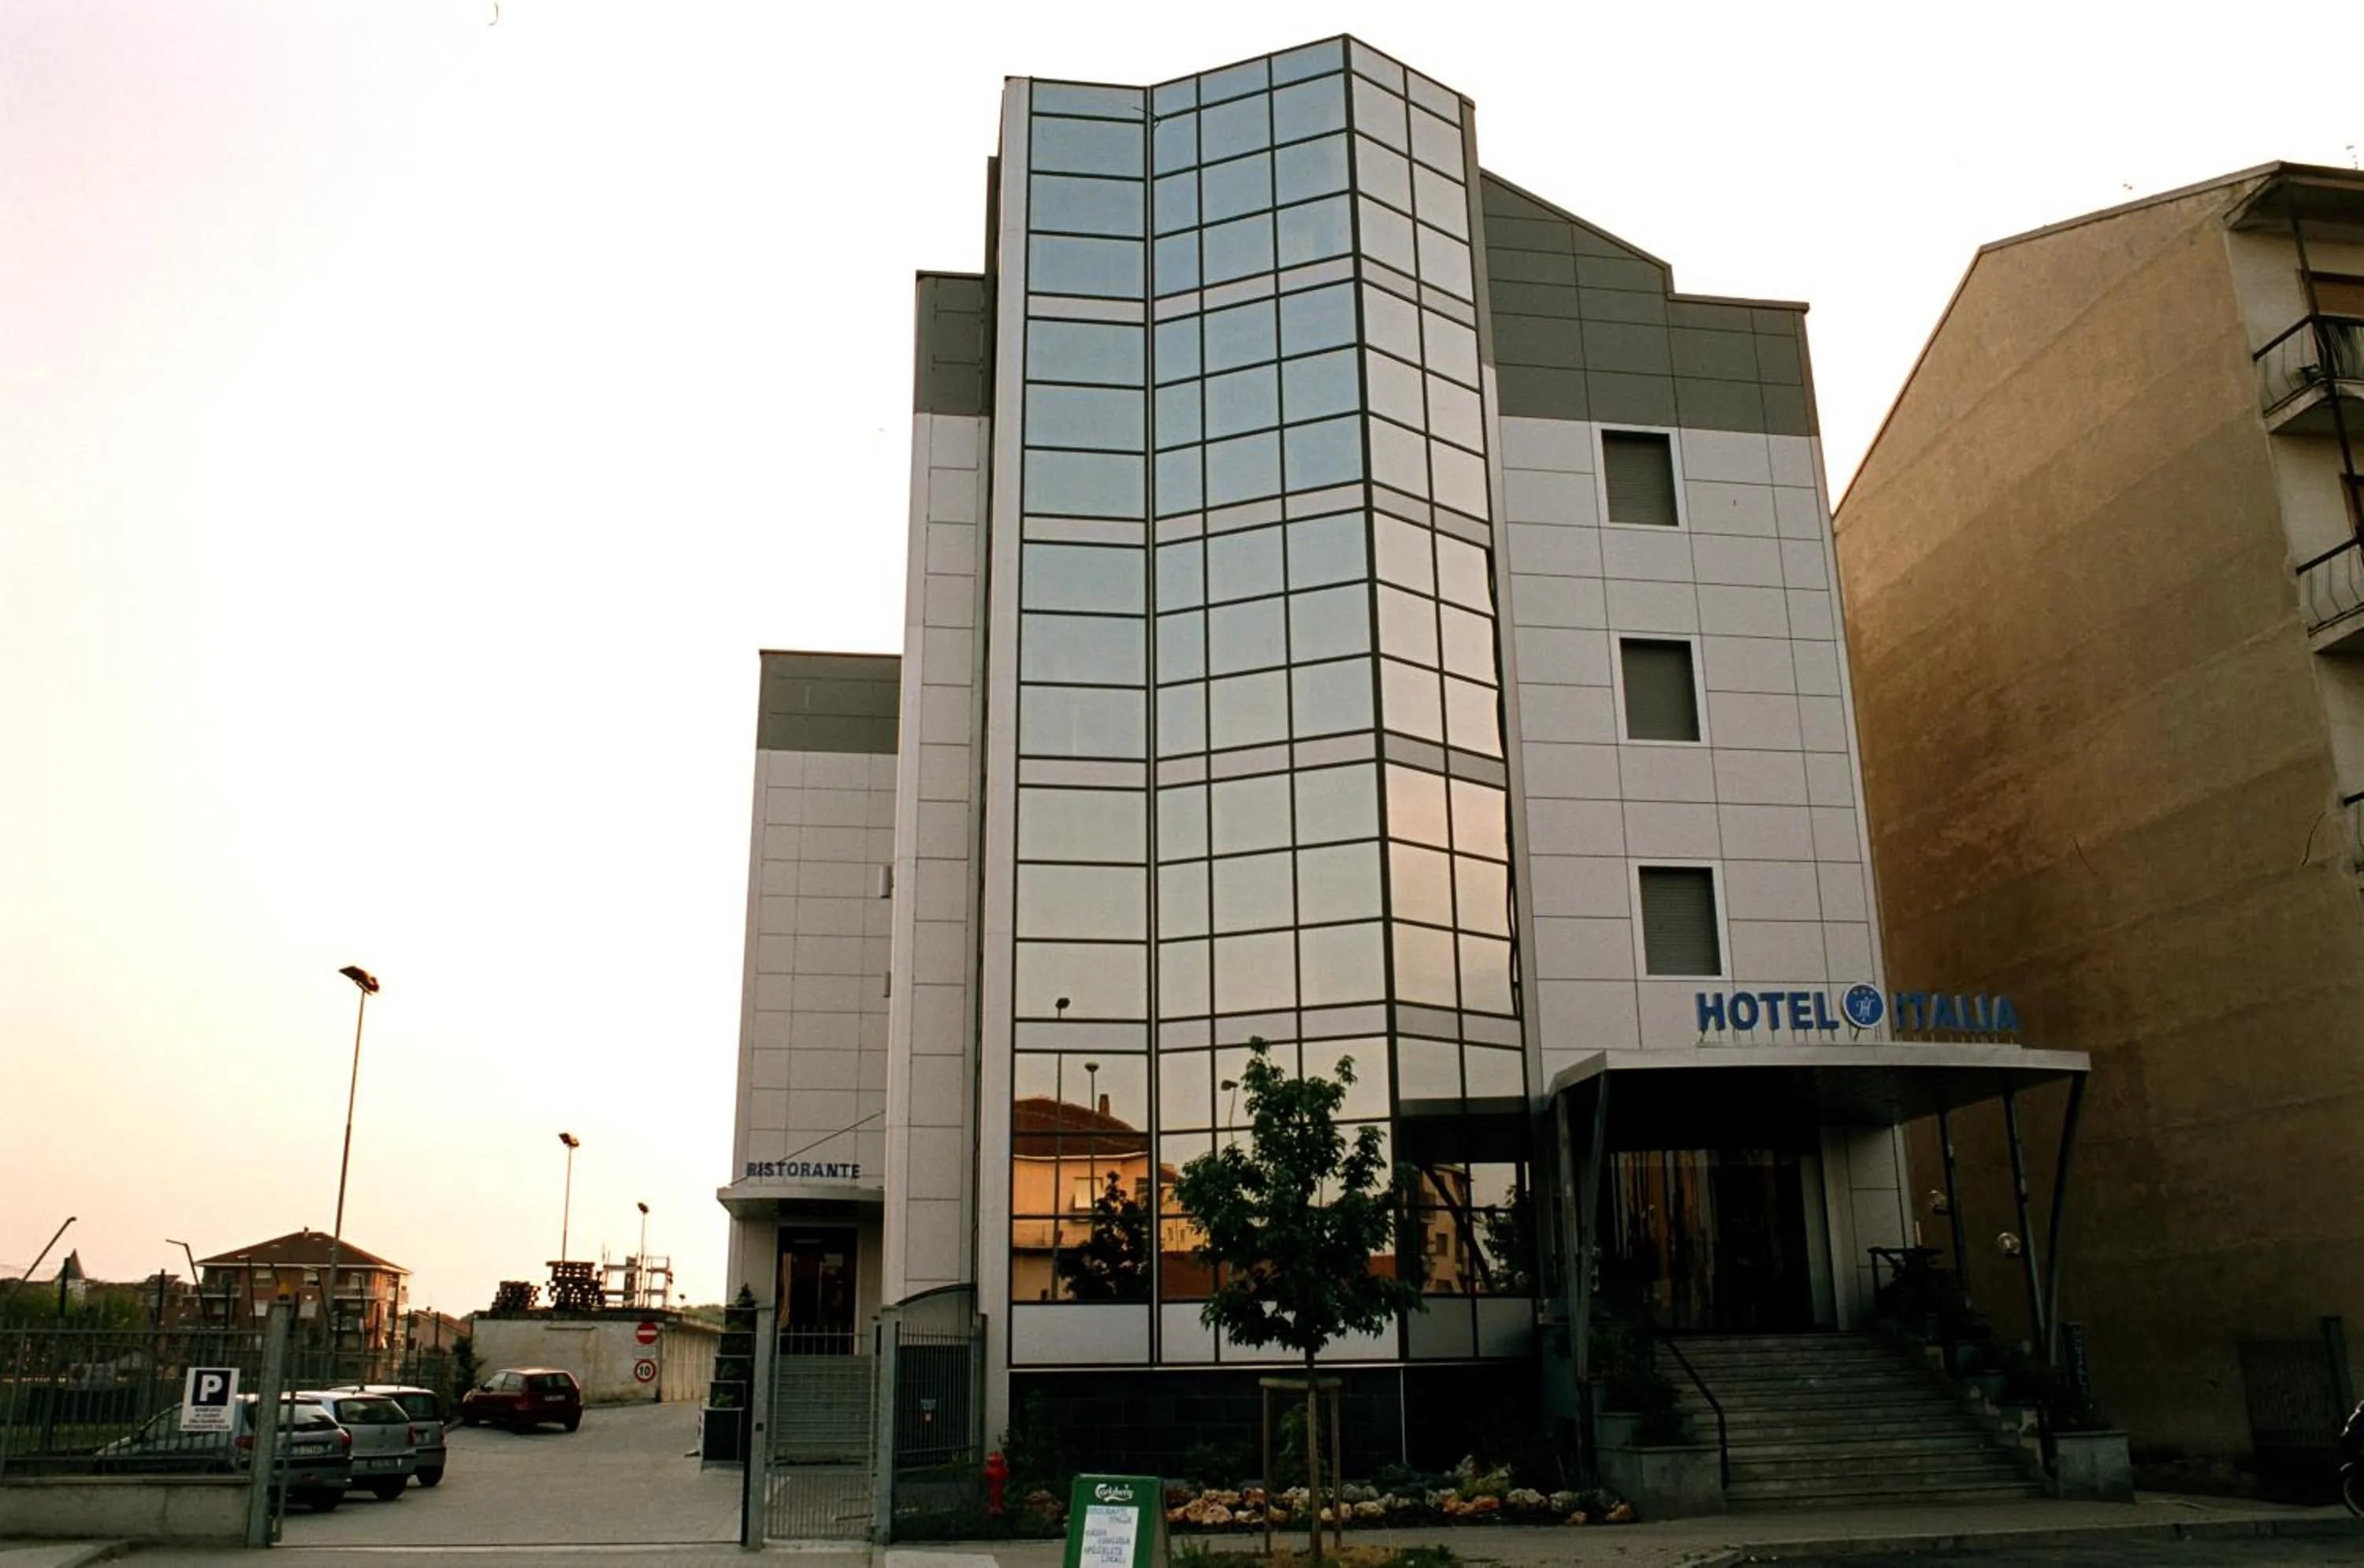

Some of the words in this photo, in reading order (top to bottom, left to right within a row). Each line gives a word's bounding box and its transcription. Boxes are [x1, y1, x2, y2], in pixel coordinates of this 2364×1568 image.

[1696, 991, 1839, 1031] HOTEL
[1891, 993, 2021, 1033] ITALIA
[746, 1161, 861, 1179] RISTORANTE
[640, 1365, 651, 1376] 10
[199, 1373, 223, 1402] P
